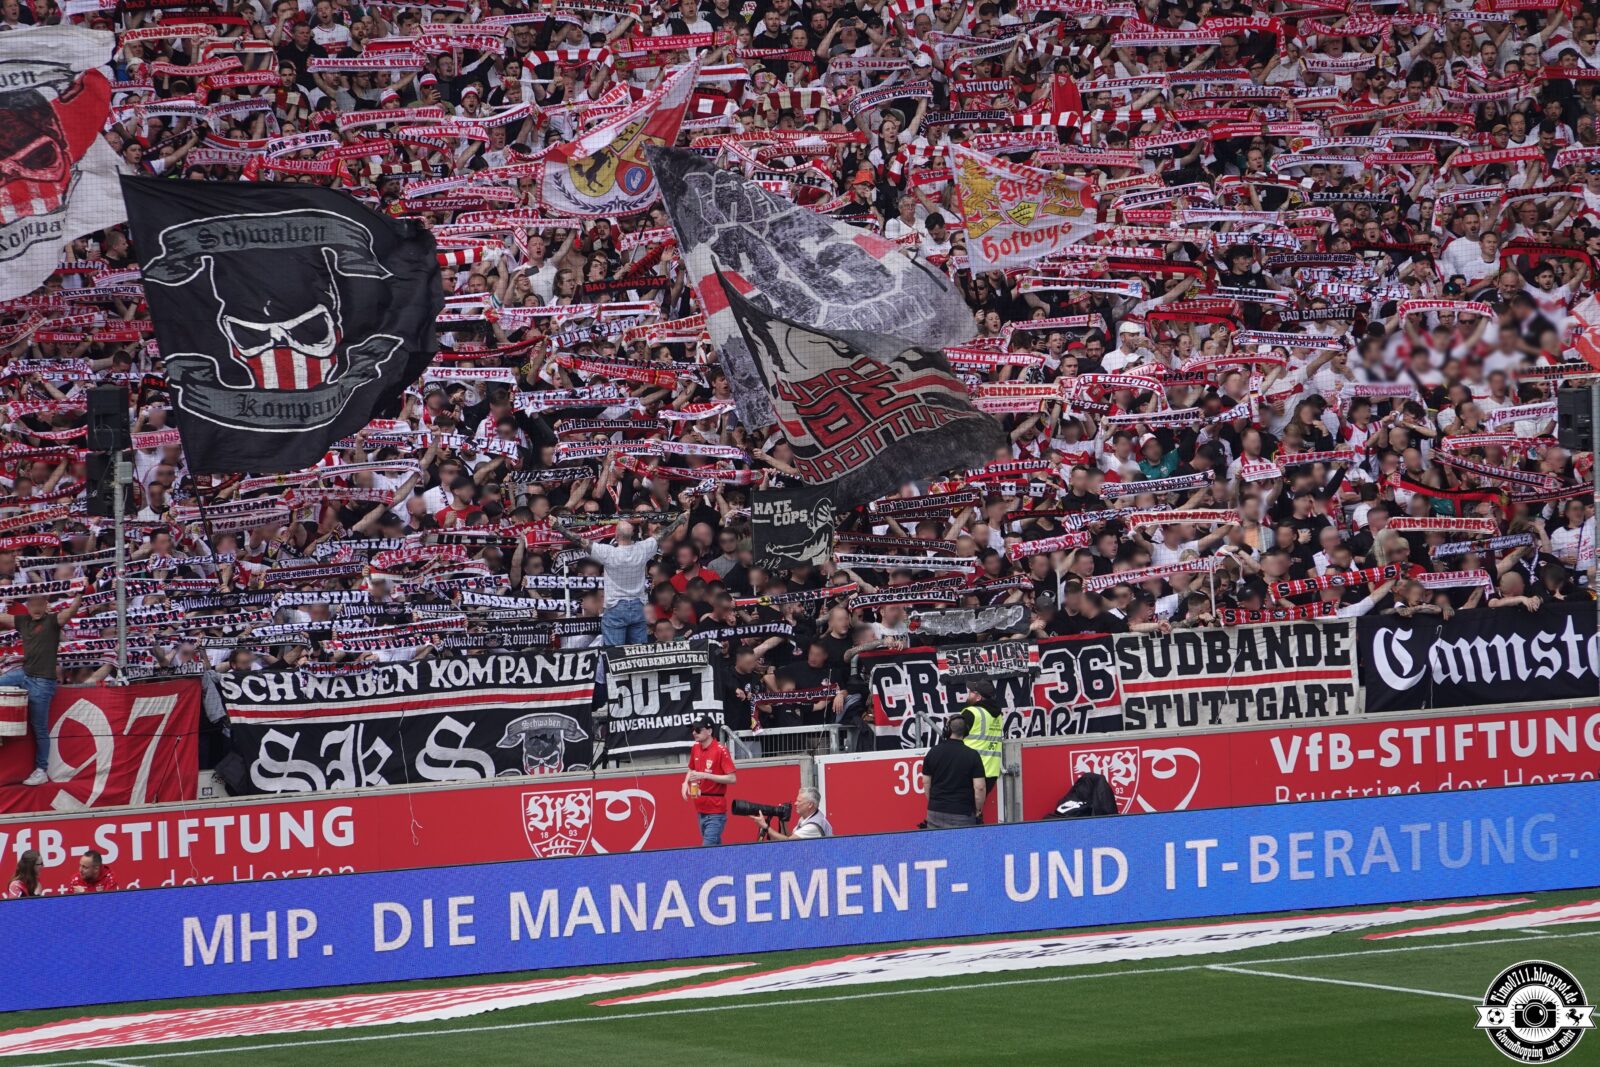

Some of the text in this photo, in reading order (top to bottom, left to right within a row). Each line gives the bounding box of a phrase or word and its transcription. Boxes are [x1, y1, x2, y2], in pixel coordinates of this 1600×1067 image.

[1204, 17, 1270, 30] SSCHLAG
[634, 36, 712, 50] VfB Stuttgart
[309, 58, 425, 67] CANNSTATTER KURVE
[1309, 60, 1326, 68] VfB
[1563, 69, 1580, 77] VfB
[1096, 78, 1160, 88] Stuttgart
[340, 109, 406, 126] CANNSTATTER
[1124, 185, 1198, 205] STUTTGART
[1313, 191, 1387, 200] STUTTGART
[404, 198, 485, 209] VfB STUTTGART
[197, 219, 326, 249] Schwaben
[981, 221, 1073, 264] Hofboys
[584, 283, 606, 292] BAD
[1280, 307, 1356, 322] BAD CANNSTATT
[53, 334, 82, 342] DONAU
[1257, 338, 1286, 346] HEISST
[432, 368, 511, 379] VfB Stuttgart
[1163, 371, 1204, 382] PAPA
[1096, 375, 1160, 390] Stuttgart
[1155, 412, 1200, 422] STADION
[1455, 457, 1549, 482] VfB STUTTGART
[1169, 476, 1197, 484] TRAGEN
[754, 499, 792, 514] HATE
[215, 514, 290, 530] VfB Stuttgart
[773, 509, 808, 526] COPS
[1434, 542, 1470, 556] NECKAR
[475, 577, 501, 588] KSC
[1086, 572, 1142, 592] SÜDBANDE
[171, 595, 221, 612] Schwaben
[463, 591, 566, 611] KESSELSTADT
[720, 627, 734, 636] 36
[343, 636, 431, 651] STUTTGART
[624, 640, 691, 656] EHRE ALLEN
[946, 641, 1030, 666] SEKTION
[1115, 622, 1351, 681] SÜDBANDE
[610, 651, 708, 672] VERSTORBENEN ULTRAS
[220, 648, 599, 702] SCHWABEN KOMPANIE
[1039, 644, 1118, 705] 36
[608, 665, 724, 719] 50+1
[1124, 682, 1355, 730] STUTTGART
[521, 718, 562, 729] Schwaben
[1270, 712, 1600, 774] VfB-STIFTUNG
[1115, 786, 1124, 795] 93
[540, 829, 578, 839] 18 93
[183, 812, 1579, 967] MHP. DIE MANAGEMENT- UND IT-BERATUNG.
